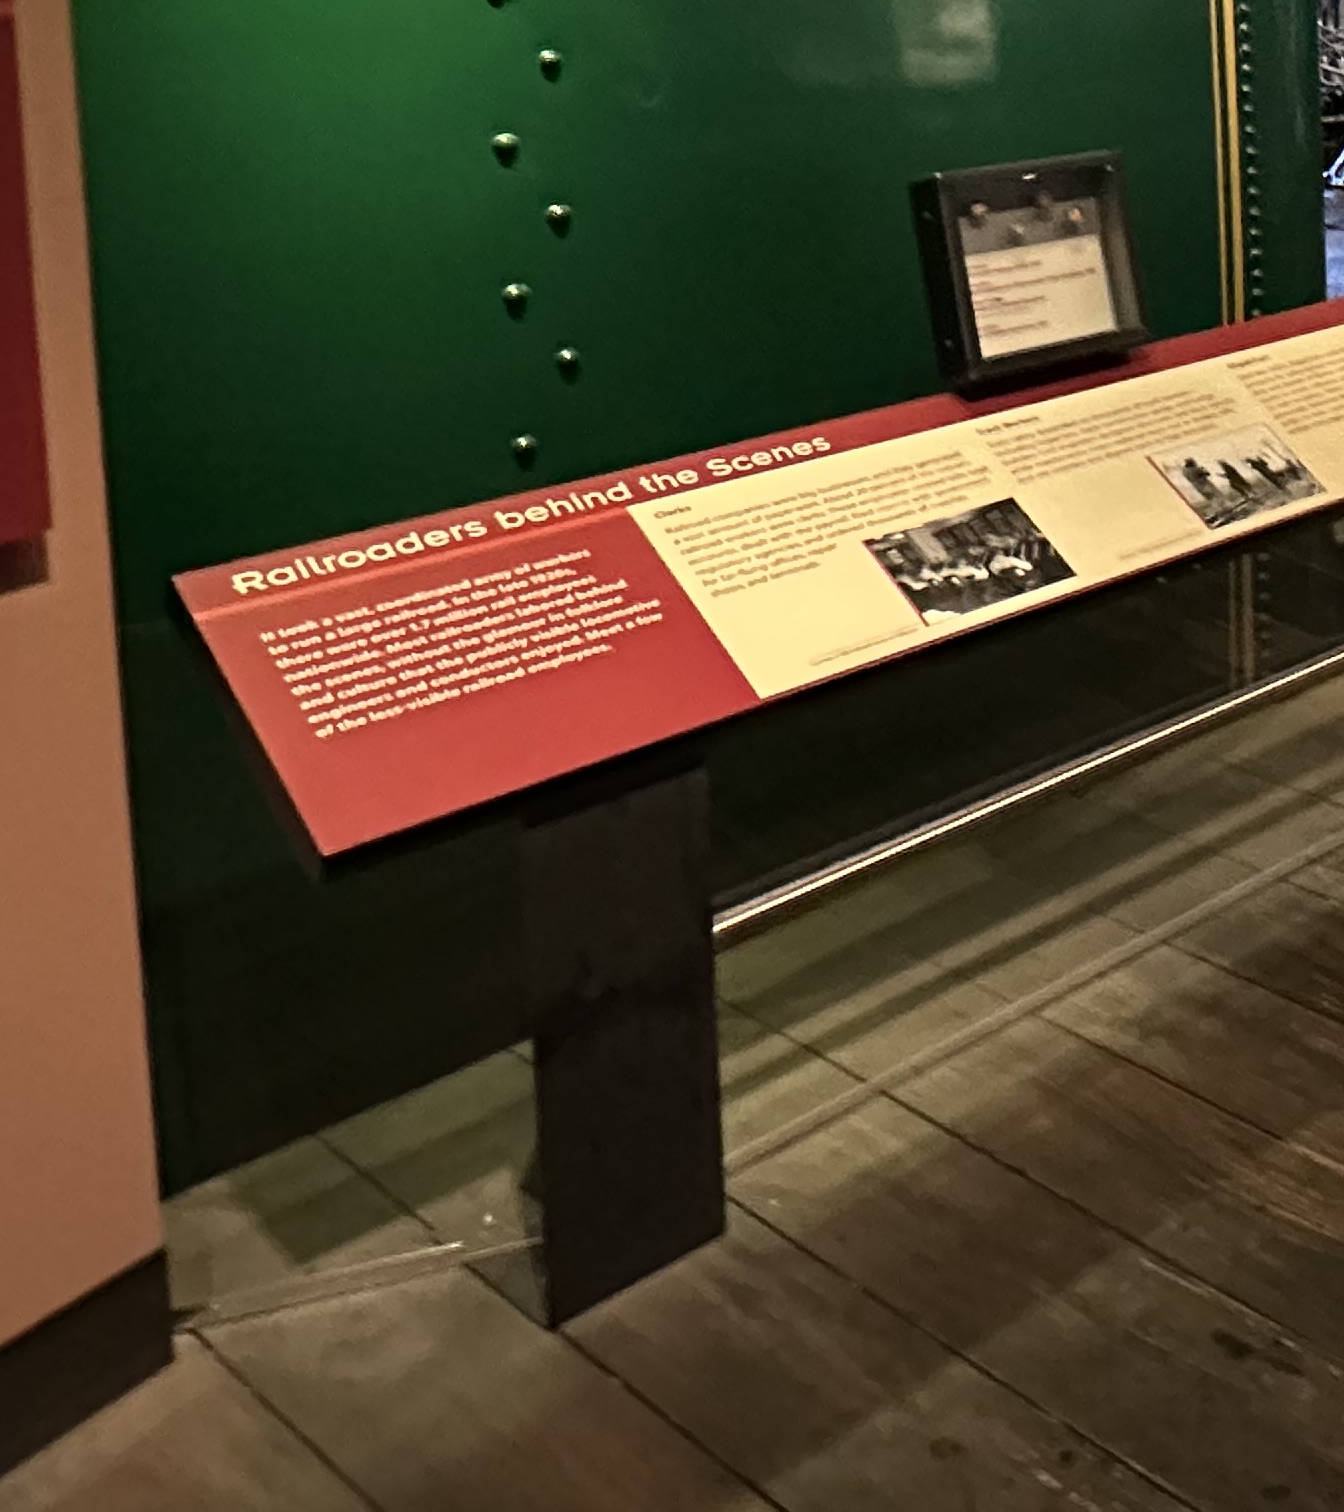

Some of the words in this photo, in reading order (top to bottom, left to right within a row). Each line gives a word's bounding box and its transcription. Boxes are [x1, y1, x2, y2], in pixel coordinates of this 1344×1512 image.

[231, 521, 488, 594] Railroaders
[494, 481, 633, 530] behind
[638, 469, 699, 493] the
[706, 437, 831, 477] Scenes
[268, 645, 289, 655] to
[291, 636, 322, 649] run
[325, 628, 338, 640] a
[337, 620, 382, 637] large
[471, 589, 497, 600] the
[498, 578, 530, 593] late
[322, 618, 333, 626] a
[473, 571, 511, 585] army
[514, 563, 531, 575] of
[386, 636, 428, 653] Most
[429, 609, 516, 641] railroaders
[574, 579, 628, 600] behind
[275, 651, 323, 669] there
[326, 639, 367, 655] were
[370, 627, 406, 643] over
[433, 606, 489, 625] million
[491, 596, 516, 610] rail
[291, 683, 321, 696] the
[387, 643, 453, 669] without
[452, 637, 480, 649] the
[300, 692, 334, 710] and
[436, 657, 464, 669] the
[530, 619, 581, 642] visible
[307, 693, 394, 723] engineers
[395, 681, 428, 698] and
[430, 656, 519, 687] conductors
[626, 618, 637, 629] a
[636, 613, 662, 625] few
[315, 724, 334, 738] of
[336, 717, 367, 731] the
[463, 667, 525, 693] railroad
